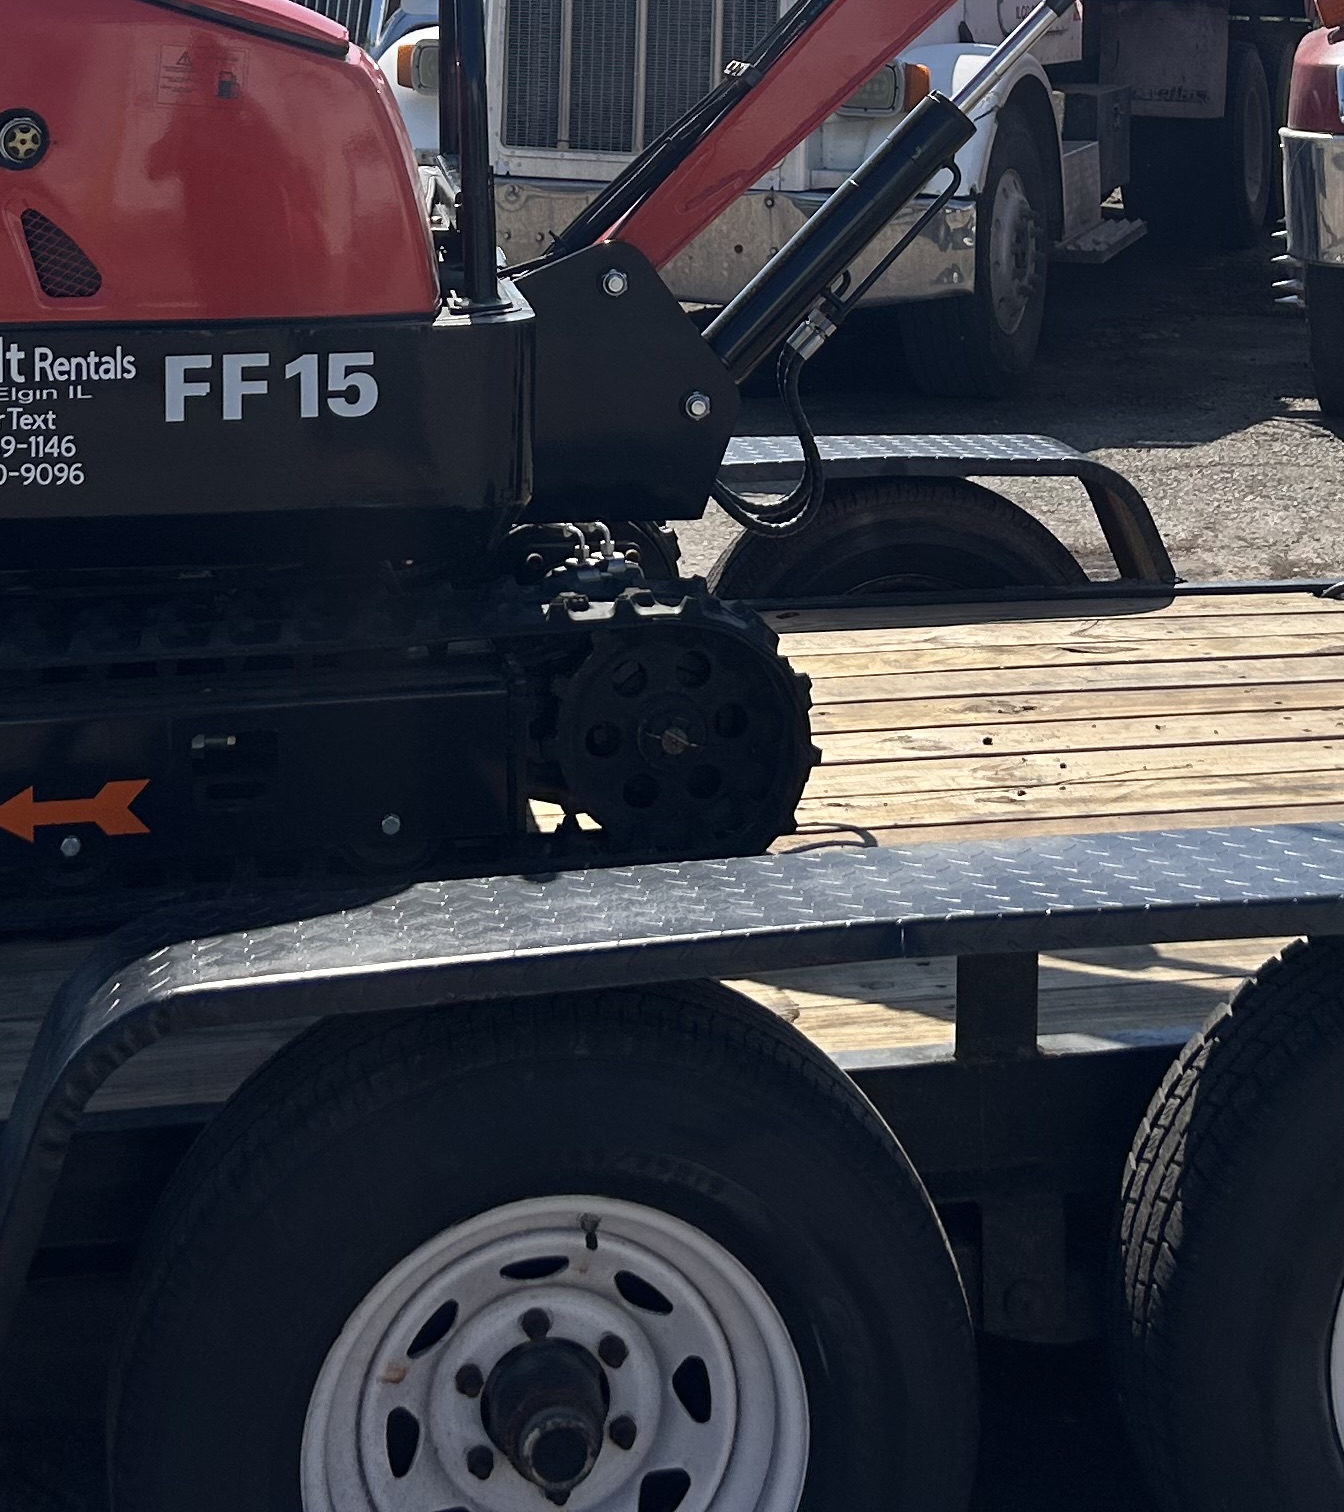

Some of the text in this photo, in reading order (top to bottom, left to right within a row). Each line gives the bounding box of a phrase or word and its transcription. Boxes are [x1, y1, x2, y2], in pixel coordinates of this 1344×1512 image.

[34, 346, 137, 382] Rentals
[68, 385, 93, 400] IL
[7, 407, 57, 431] Text
